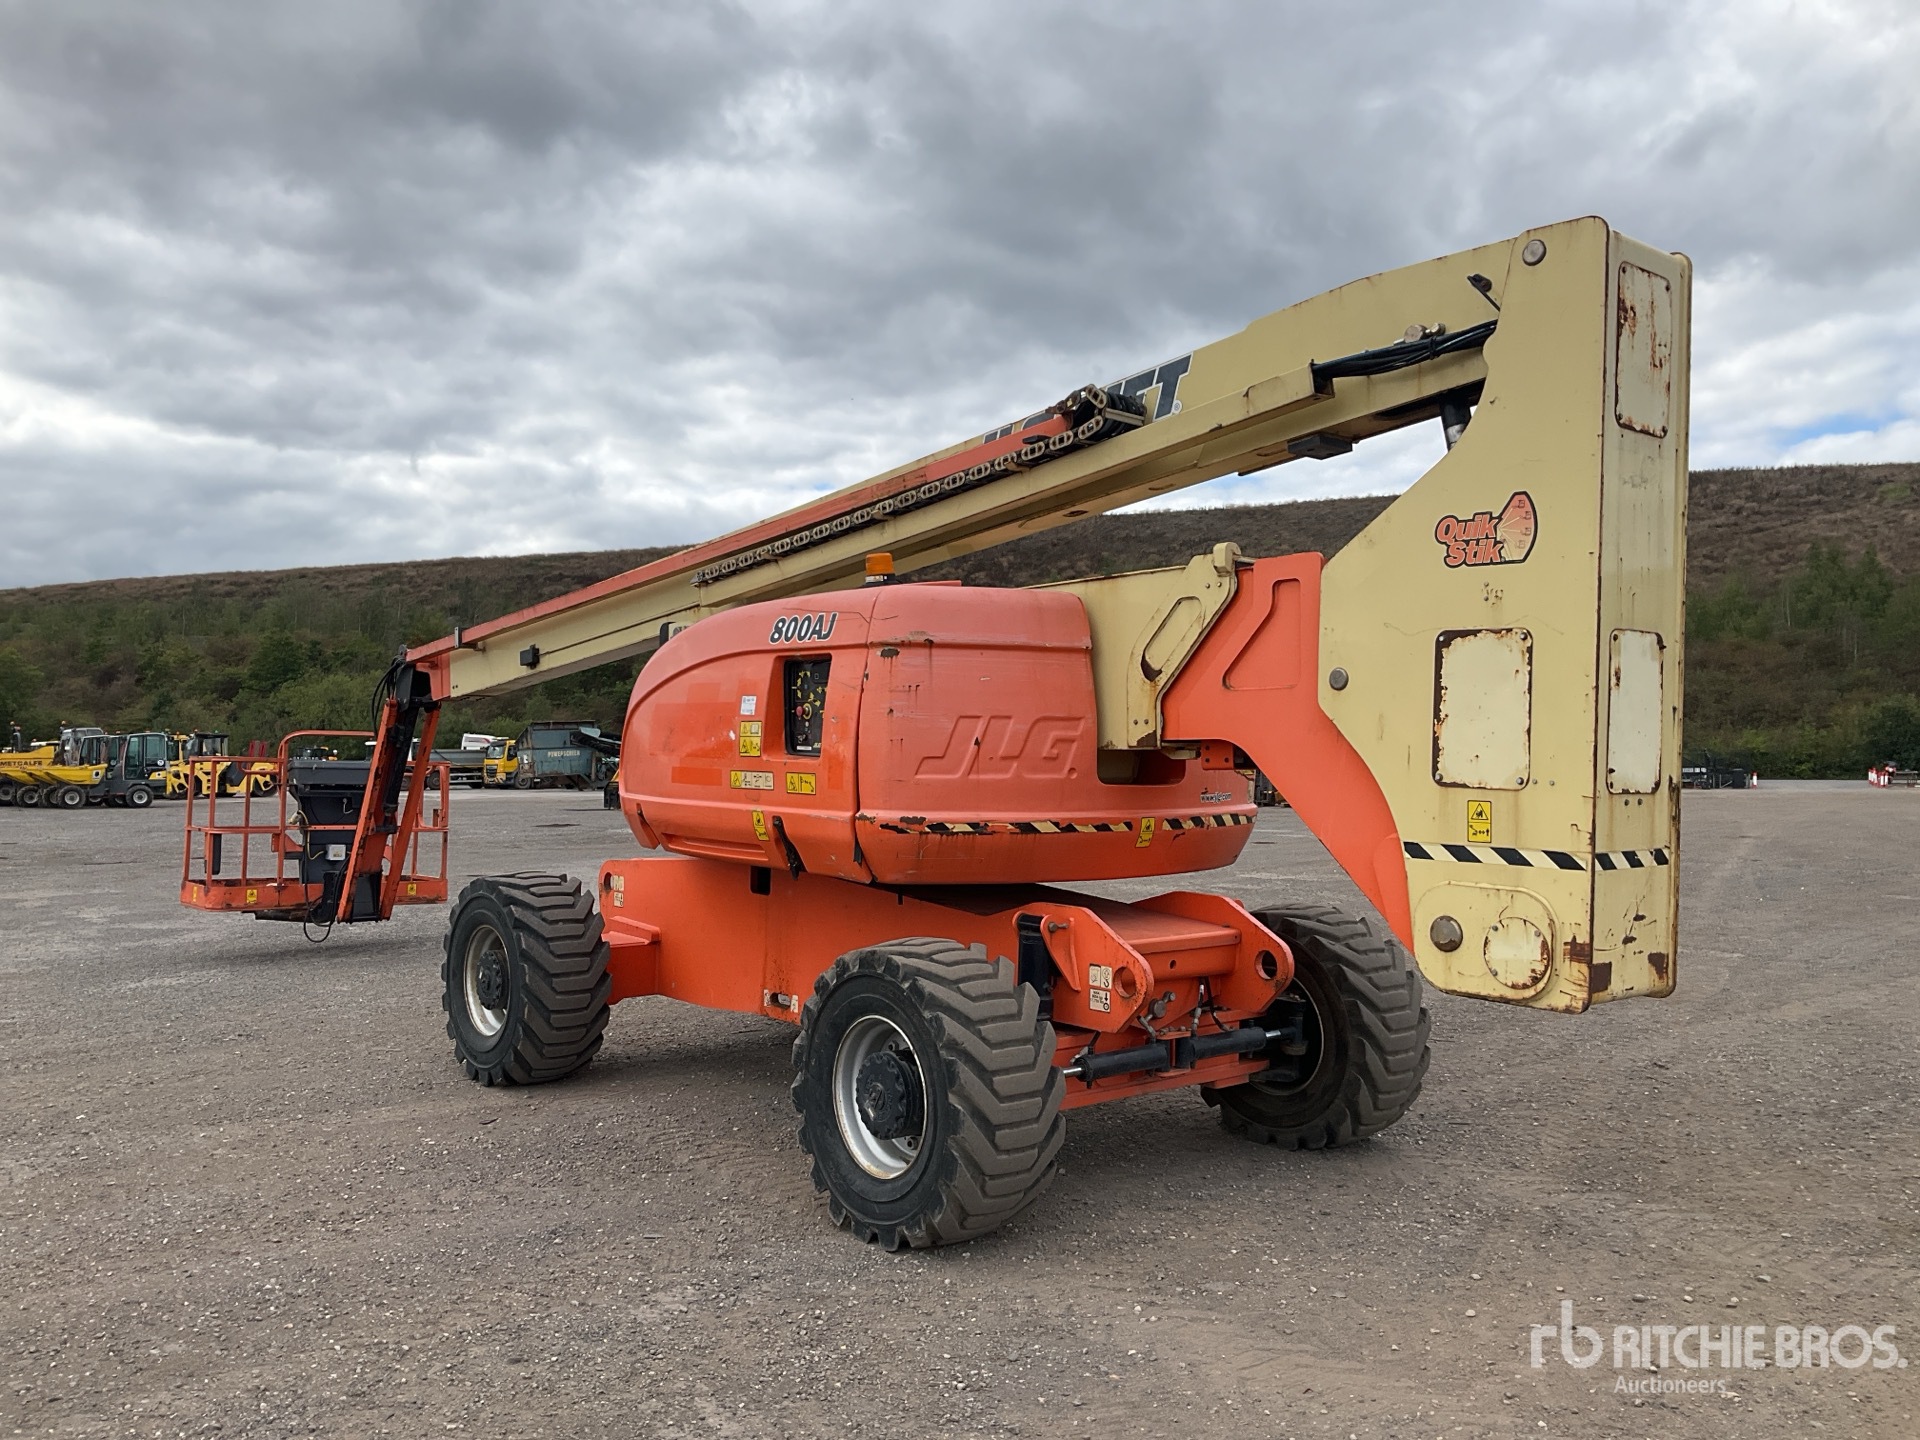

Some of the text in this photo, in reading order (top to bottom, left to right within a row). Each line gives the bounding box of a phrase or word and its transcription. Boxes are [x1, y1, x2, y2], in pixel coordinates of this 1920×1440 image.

[1436, 513, 1499, 545] Quik
[1445, 538, 1504, 566] Stik
[769, 612, 838, 644] 800AJ
